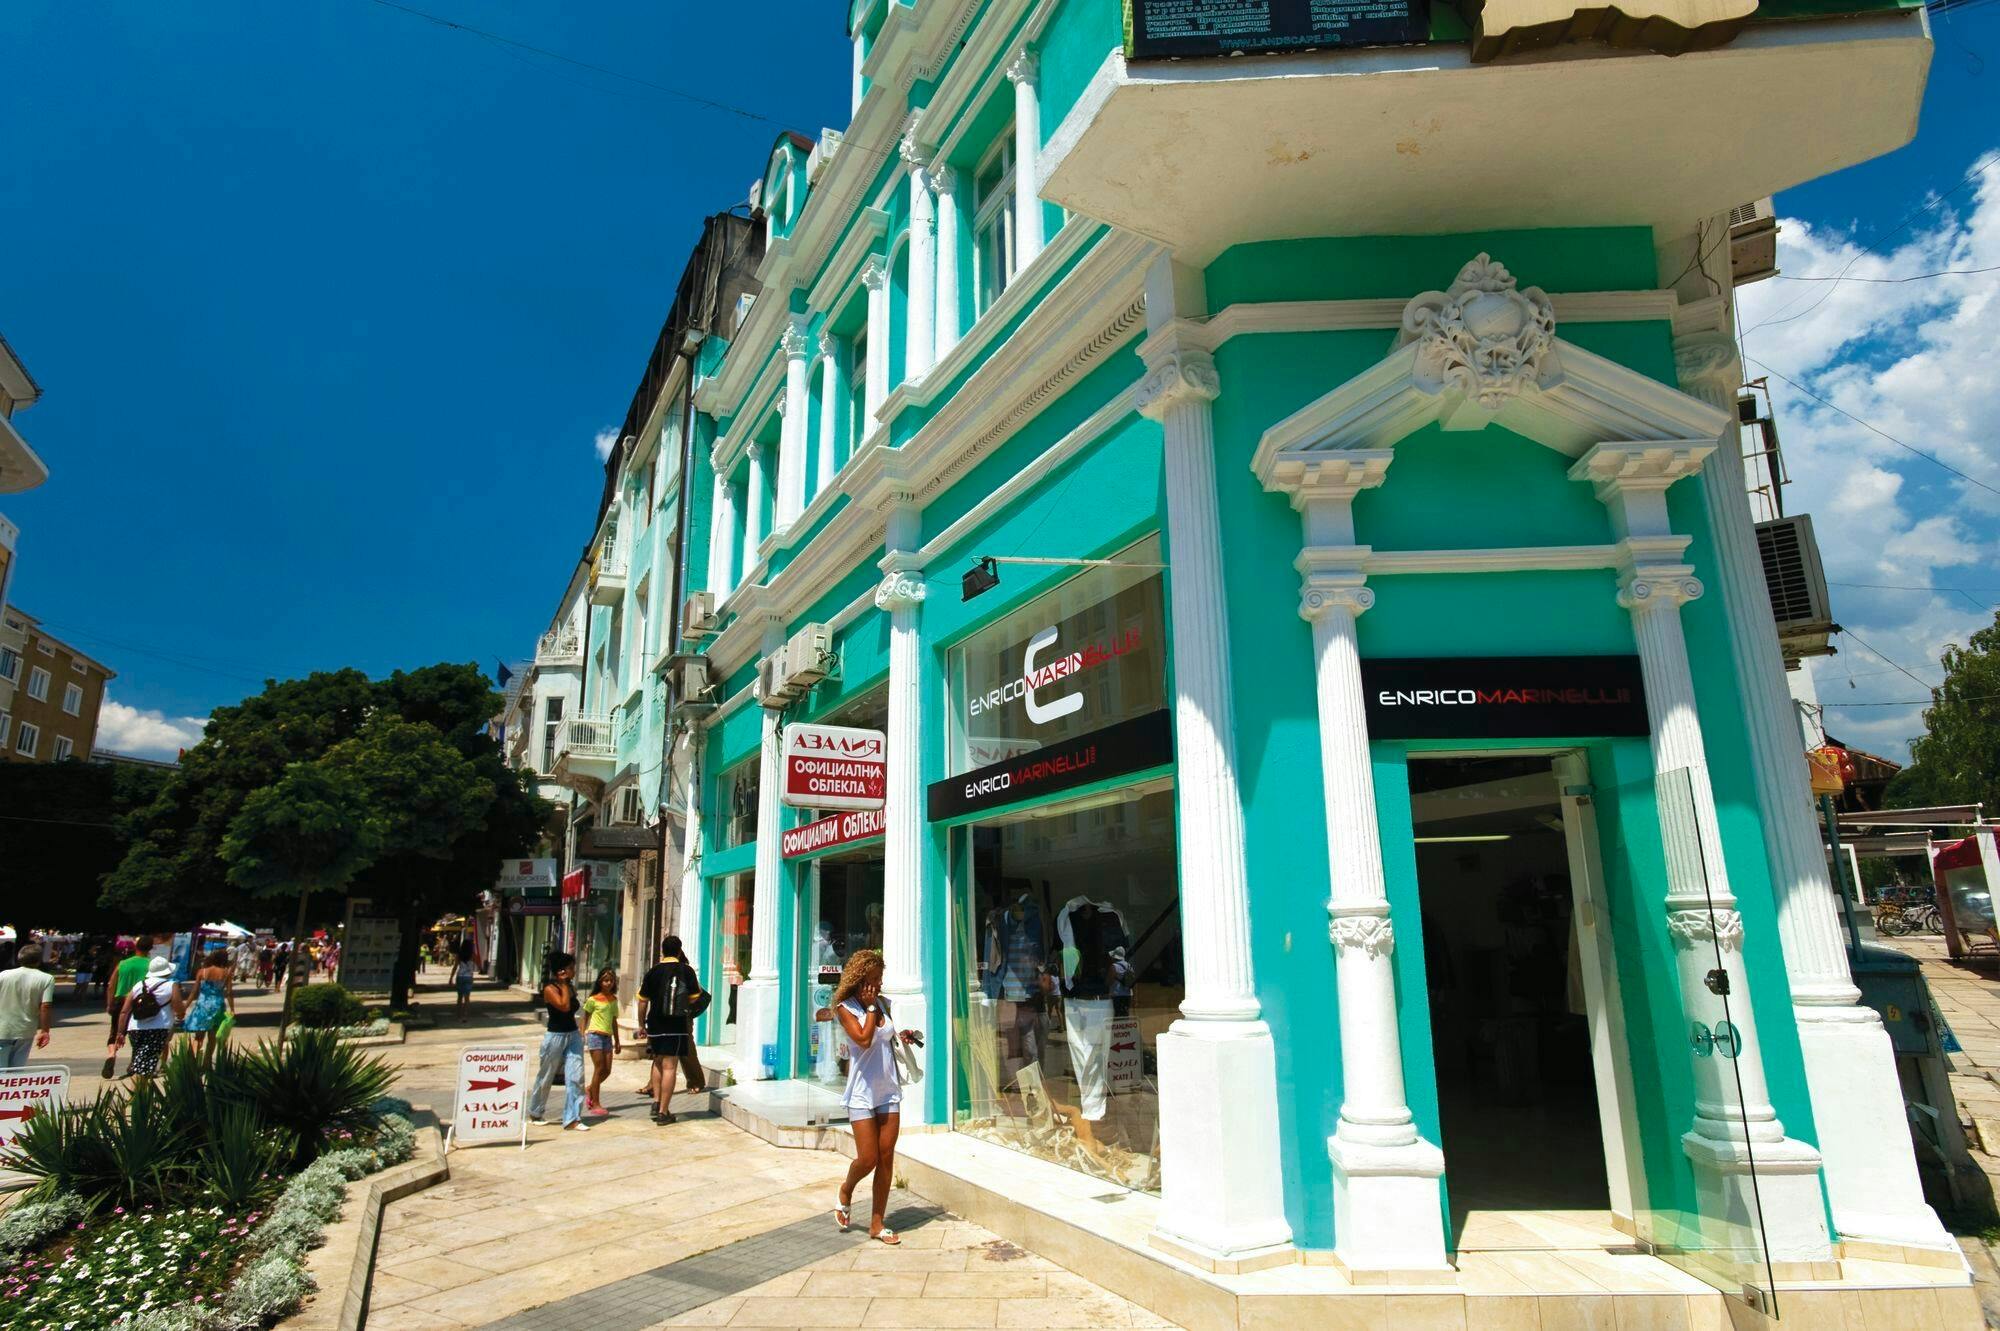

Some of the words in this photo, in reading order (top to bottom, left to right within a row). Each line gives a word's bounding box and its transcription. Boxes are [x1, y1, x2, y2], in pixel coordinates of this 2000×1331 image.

[793, 733, 881, 758] АЗАЛИЯ
[795, 760, 881, 779] ОФИЦИАЛНИ
[809, 778, 866, 794] ОБЛЕКЛА
[783, 819, 838, 854] ОФИЦИАЛНИ
[466, 1054, 524, 1062] ОФИЦИАЛНИ
[479, 1065, 509, 1073] РОКЛИ
[461, 1101, 519, 1115] АЗАЛИЯ
[481, 1119, 509, 1129] ЕТАЖ
